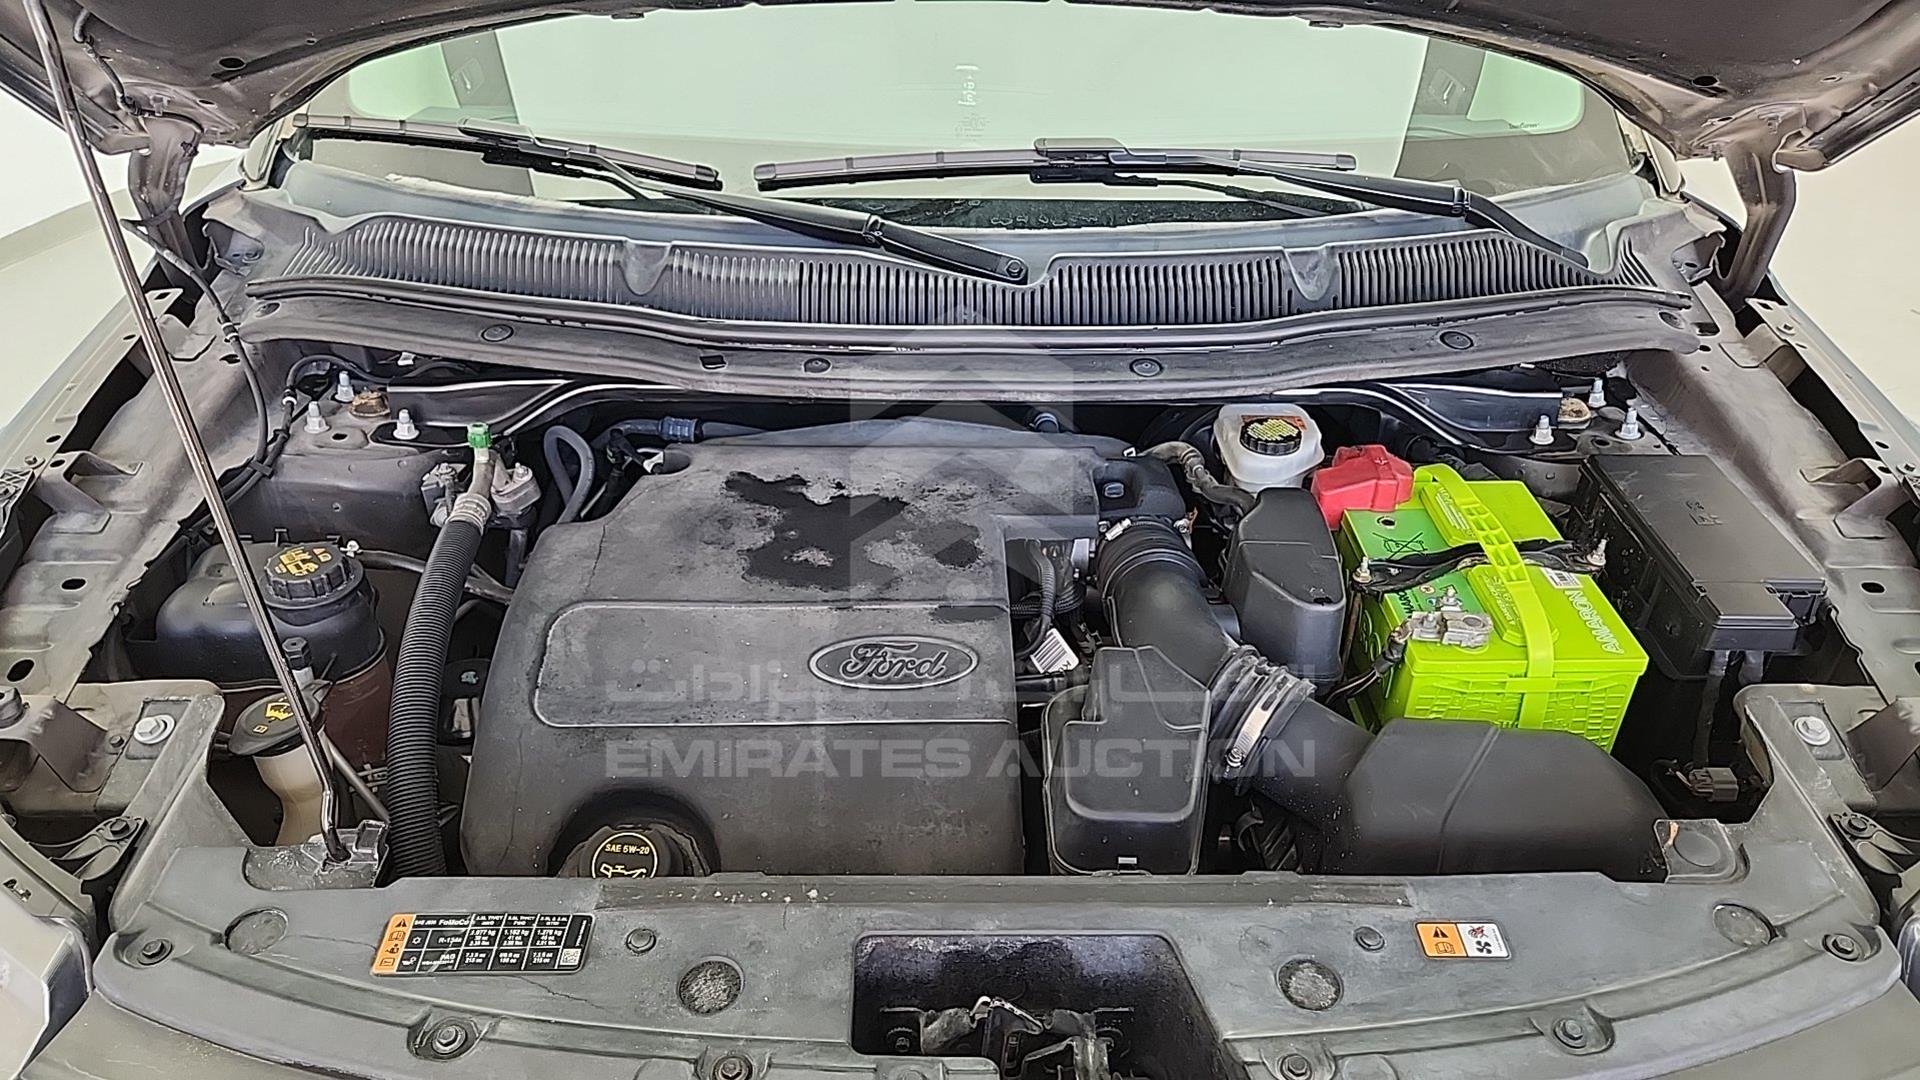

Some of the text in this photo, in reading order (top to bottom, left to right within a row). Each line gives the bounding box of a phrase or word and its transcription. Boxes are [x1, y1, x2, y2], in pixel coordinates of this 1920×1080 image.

[1563, 589, 1626, 655] AMARON
[839, 642, 948, 679] Ford
[605, 843, 650, 854] SAE 5W-20
